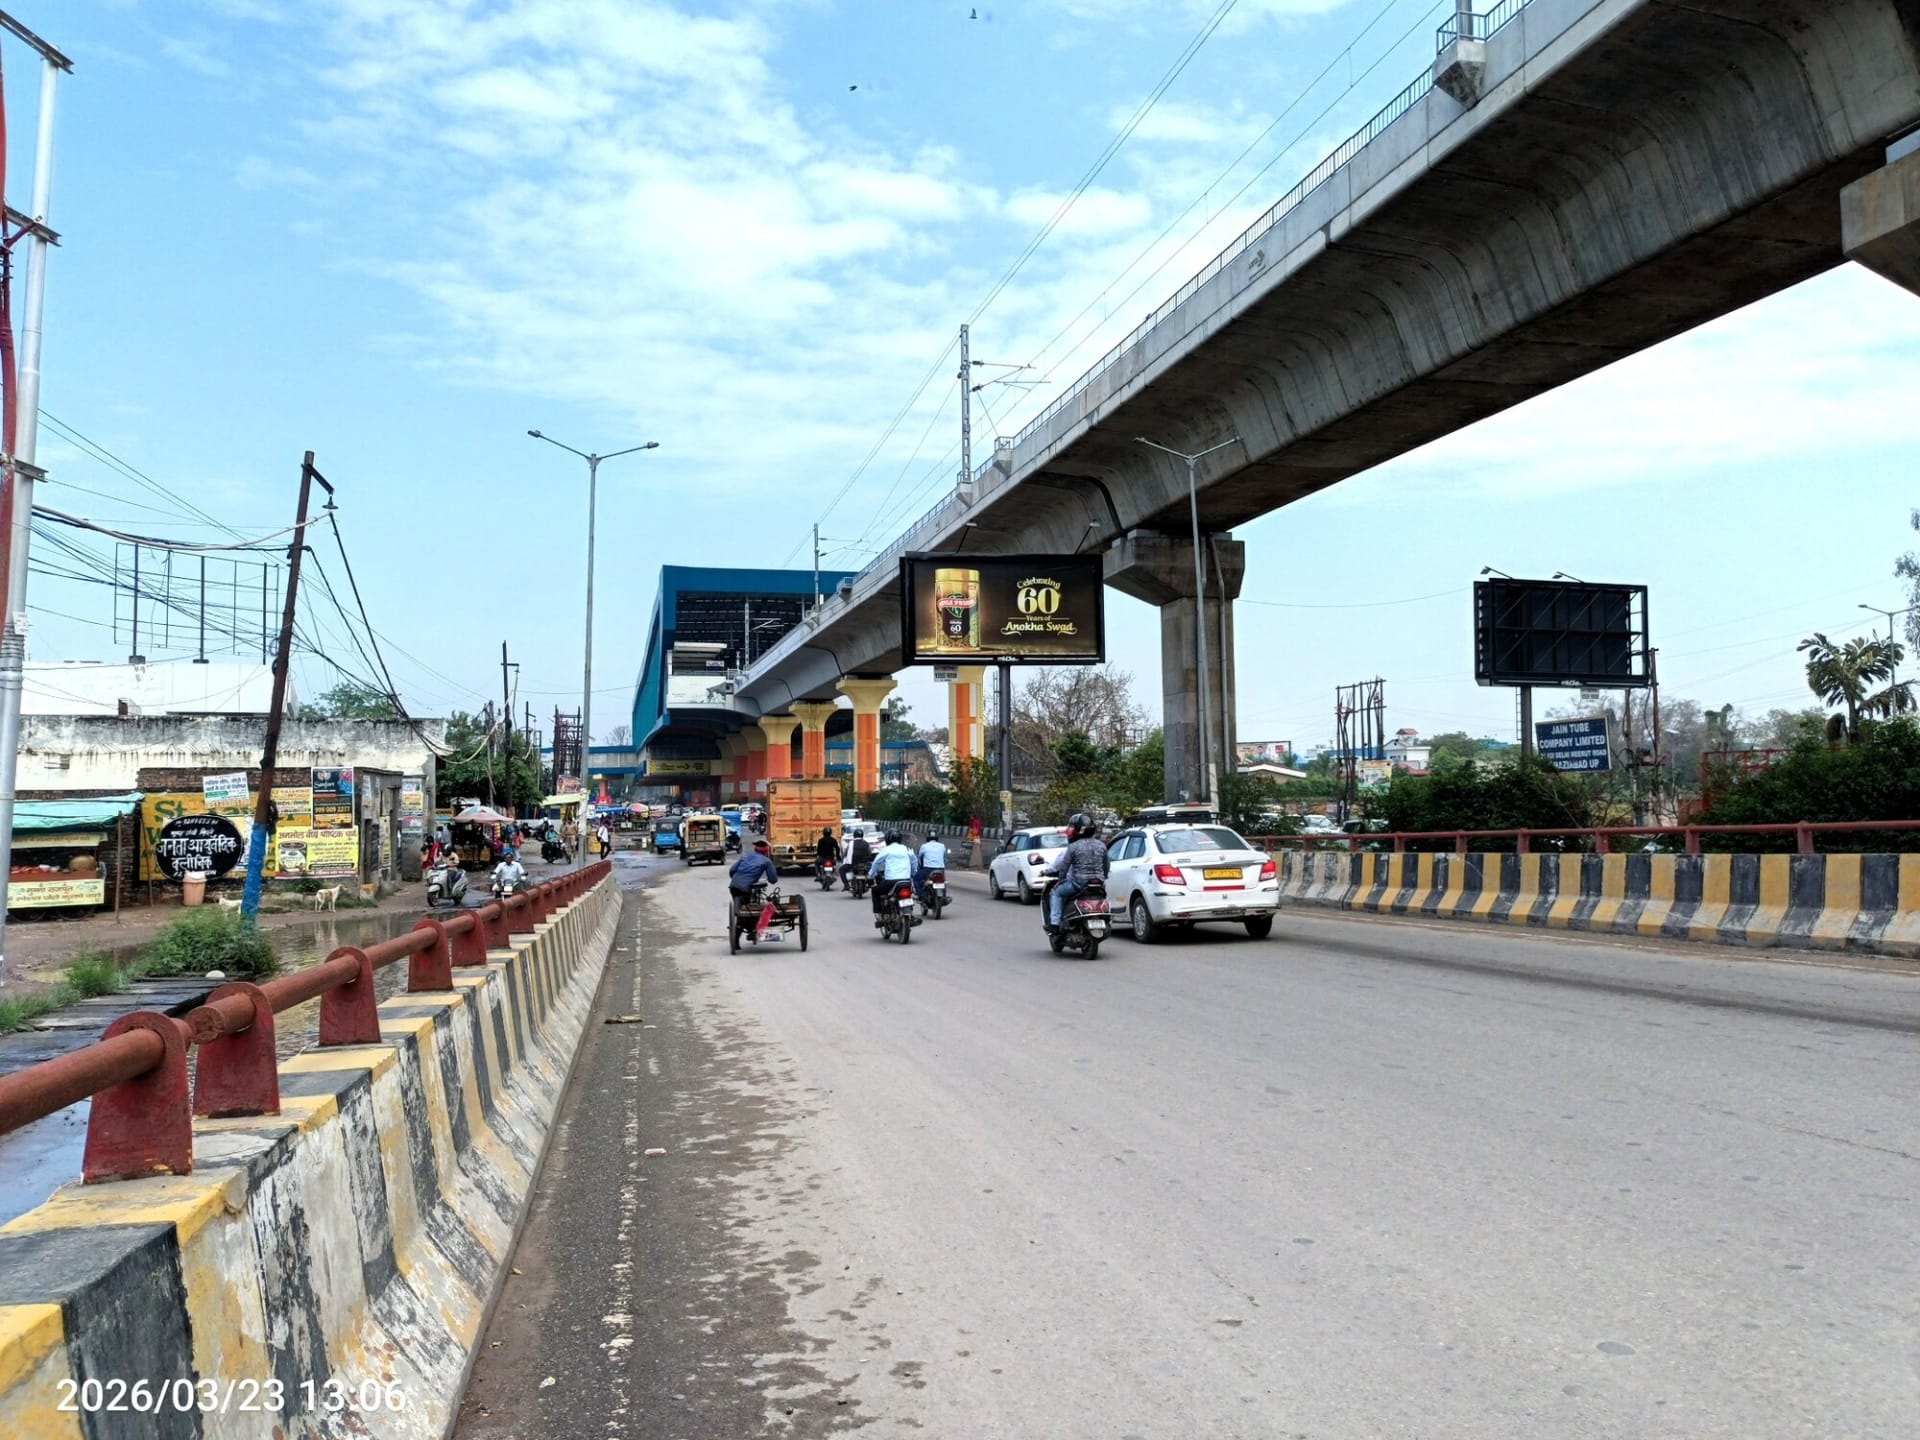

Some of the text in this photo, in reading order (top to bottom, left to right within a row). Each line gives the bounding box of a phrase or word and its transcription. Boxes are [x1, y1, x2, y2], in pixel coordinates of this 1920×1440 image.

[1017, 577, 1061, 590] Celebrating
[1017, 587, 1060, 614] 60
[1006, 622, 1073, 631] Anokha Swad
[1551, 722, 1590, 735] JAIN TUBE
[1539, 735, 1605, 749] COMPANY LIMITED
[1589, 759, 1600, 769] UP
[157, 838, 189, 856] जनता
